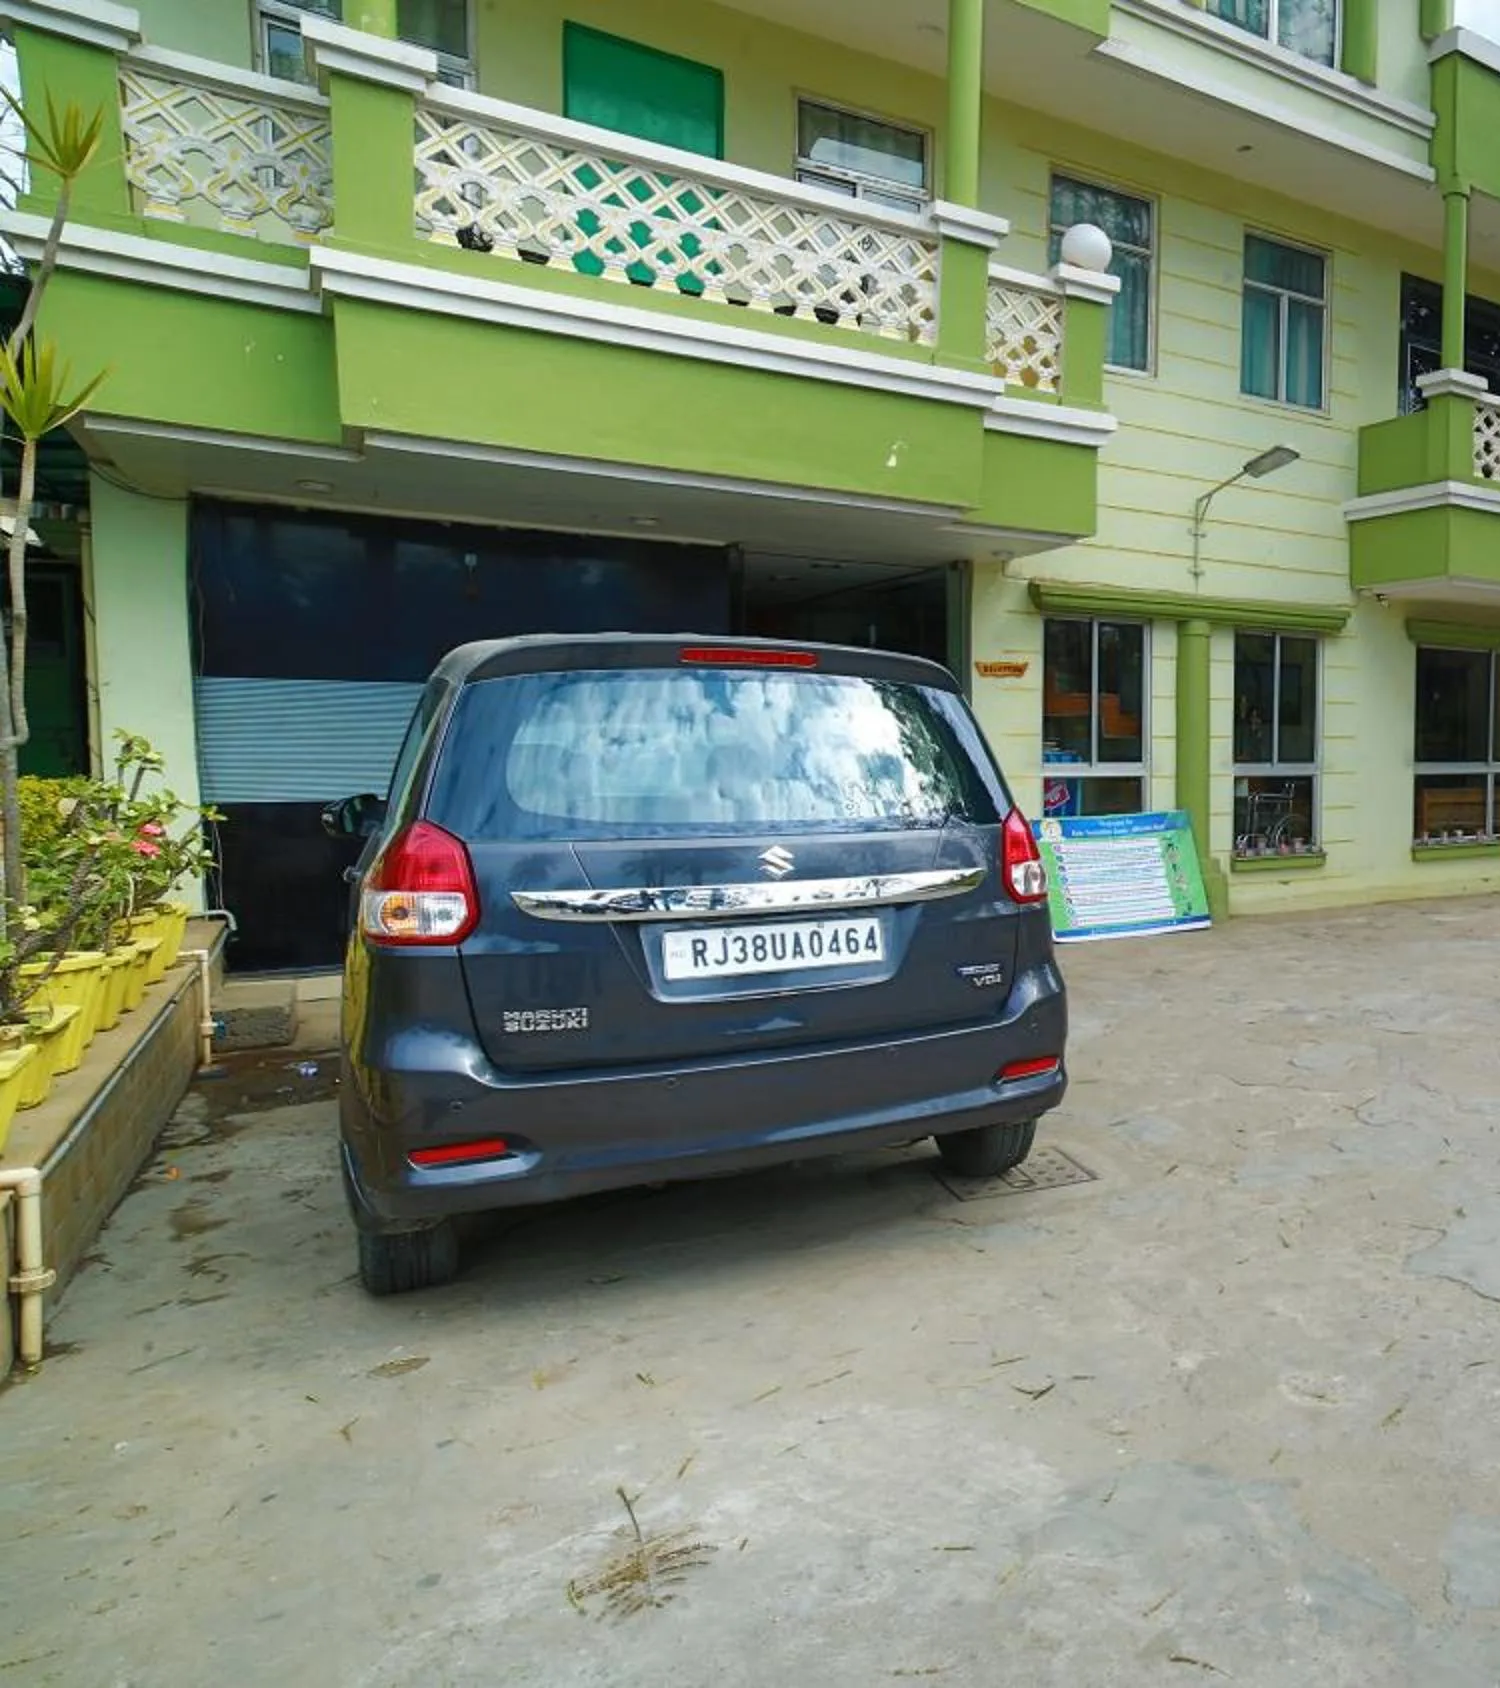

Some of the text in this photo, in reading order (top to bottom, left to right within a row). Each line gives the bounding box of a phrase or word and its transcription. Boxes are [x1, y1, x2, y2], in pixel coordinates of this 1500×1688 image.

[691, 926, 878, 968] RJ38UA0464
[503, 1007, 588, 1021] MARUTI
[503, 1017, 588, 1033] SUZUKI
